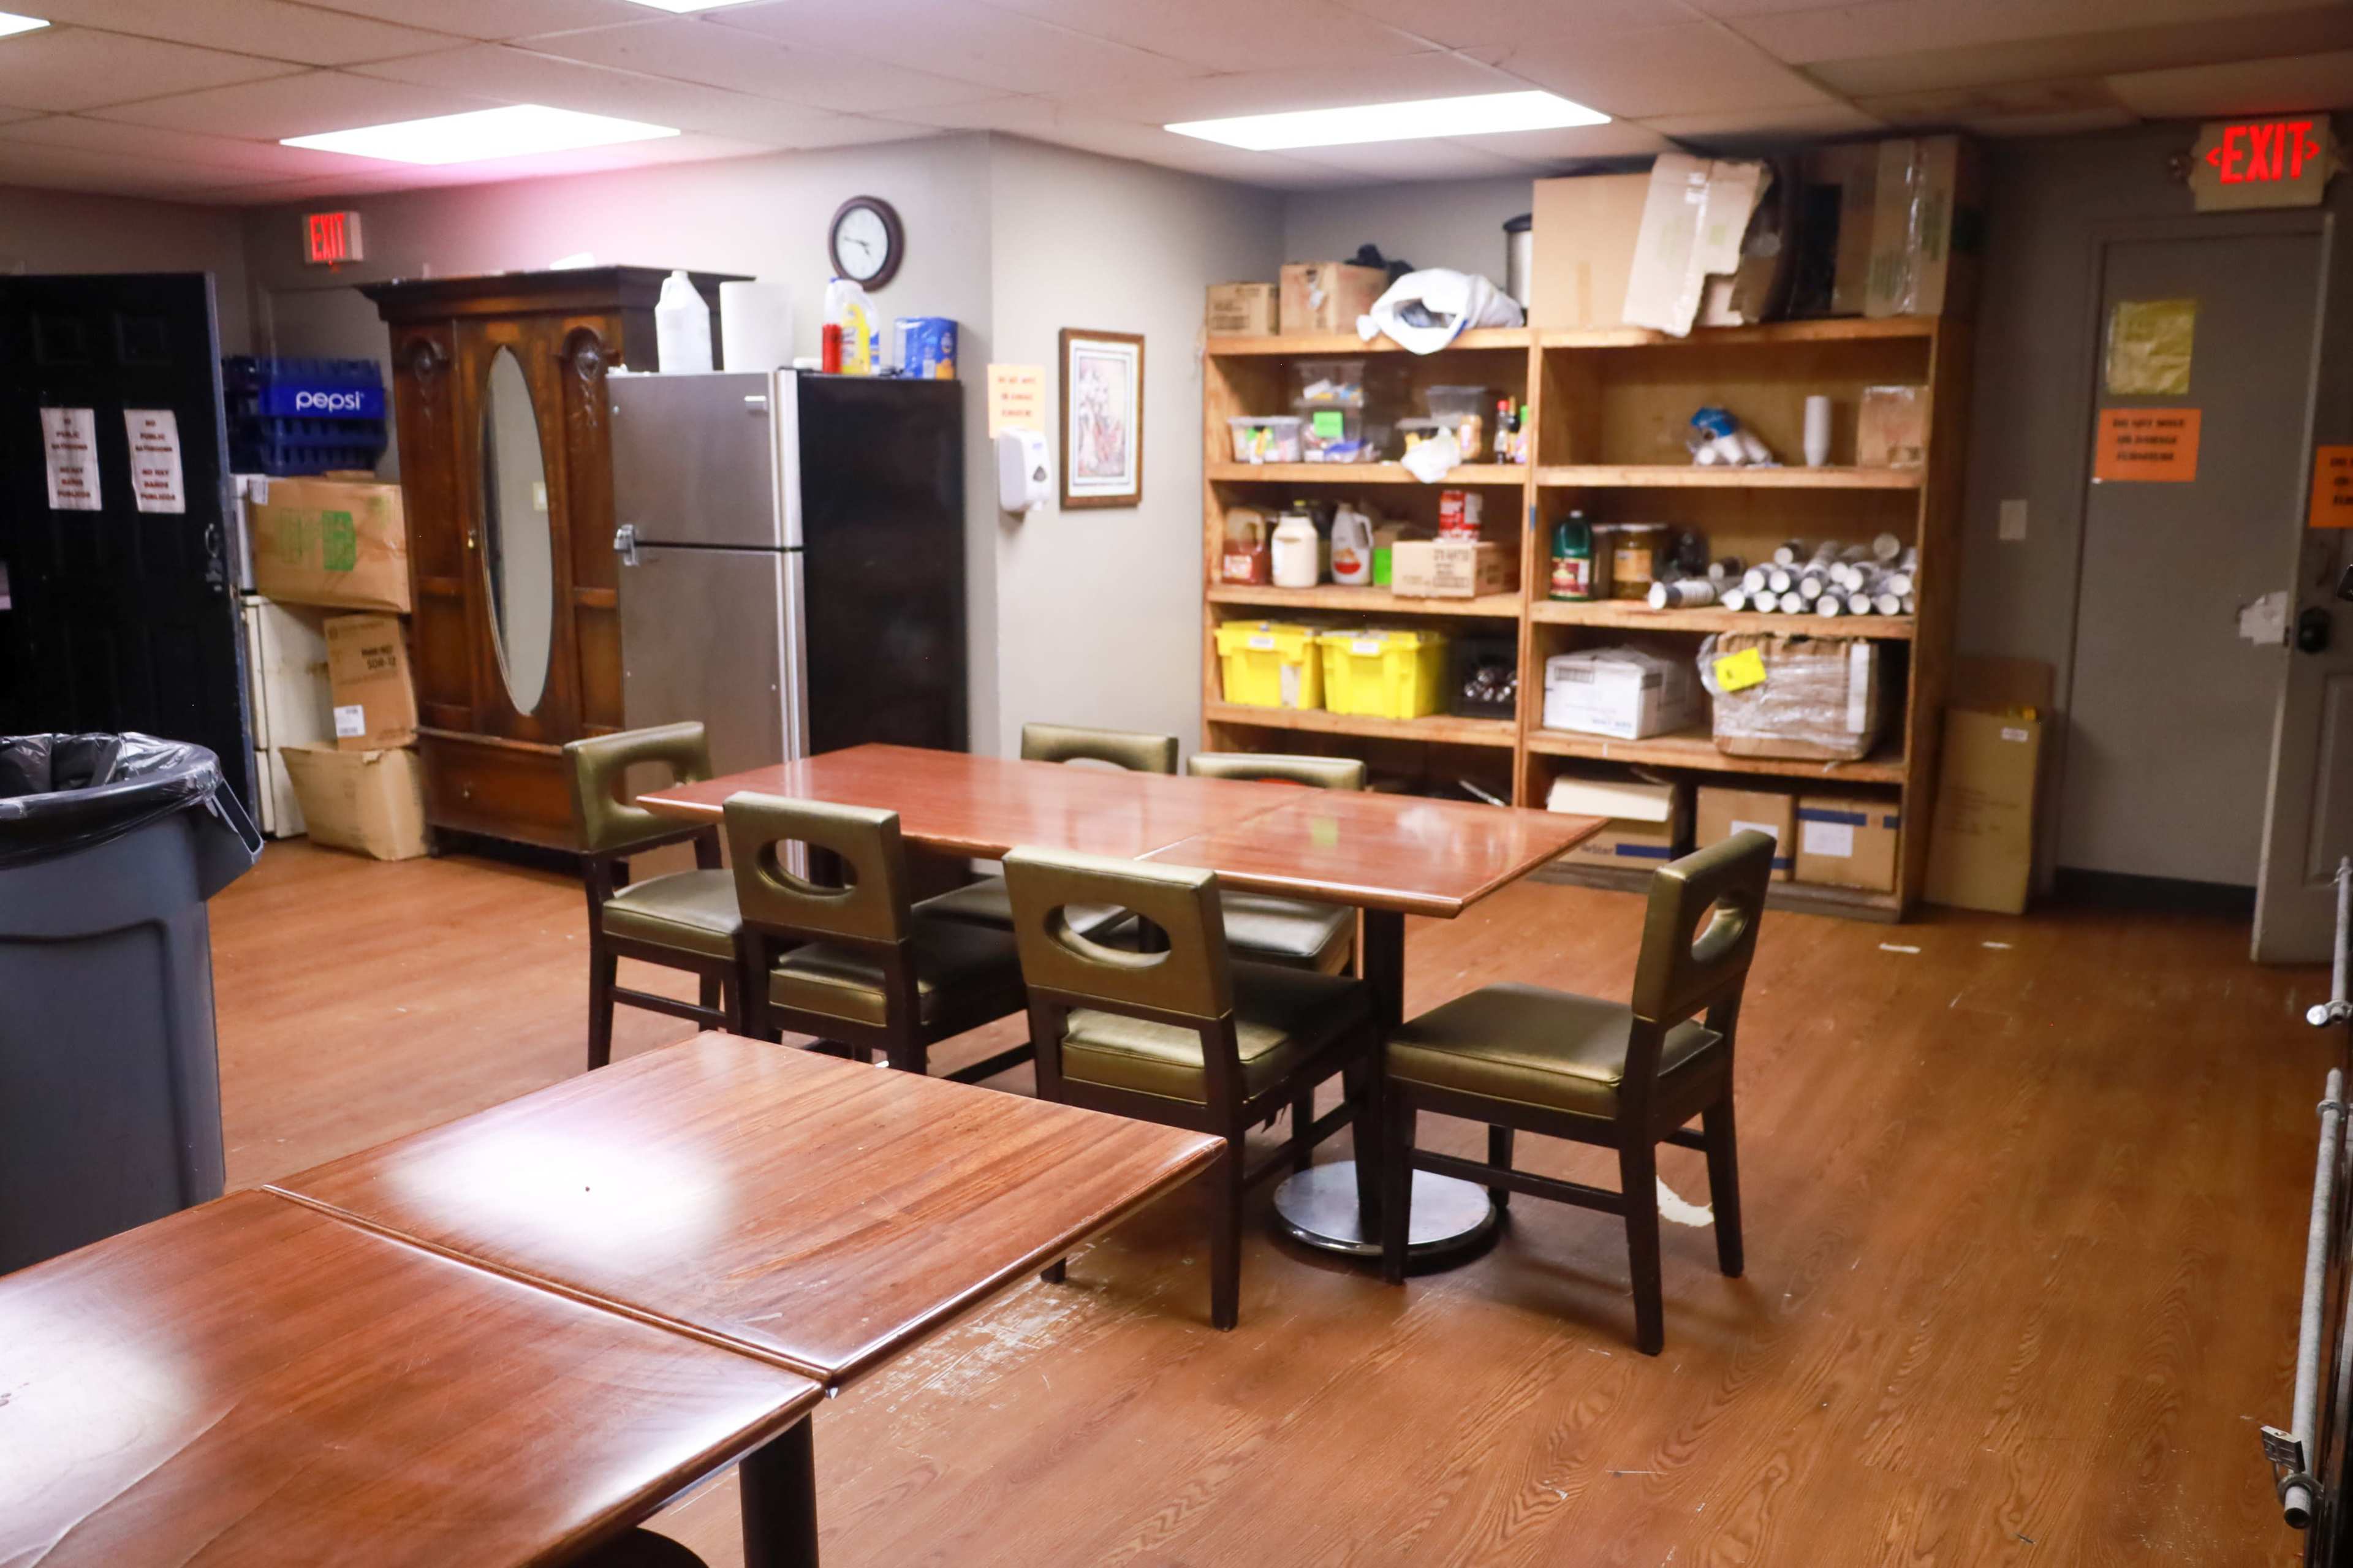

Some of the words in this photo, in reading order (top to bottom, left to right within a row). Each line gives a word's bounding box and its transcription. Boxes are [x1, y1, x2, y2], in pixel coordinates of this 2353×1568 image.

[2220, 120, 2313, 184] EXIT
[310, 213, 346, 261] EXIT
[296, 390, 360, 413] pepsi
